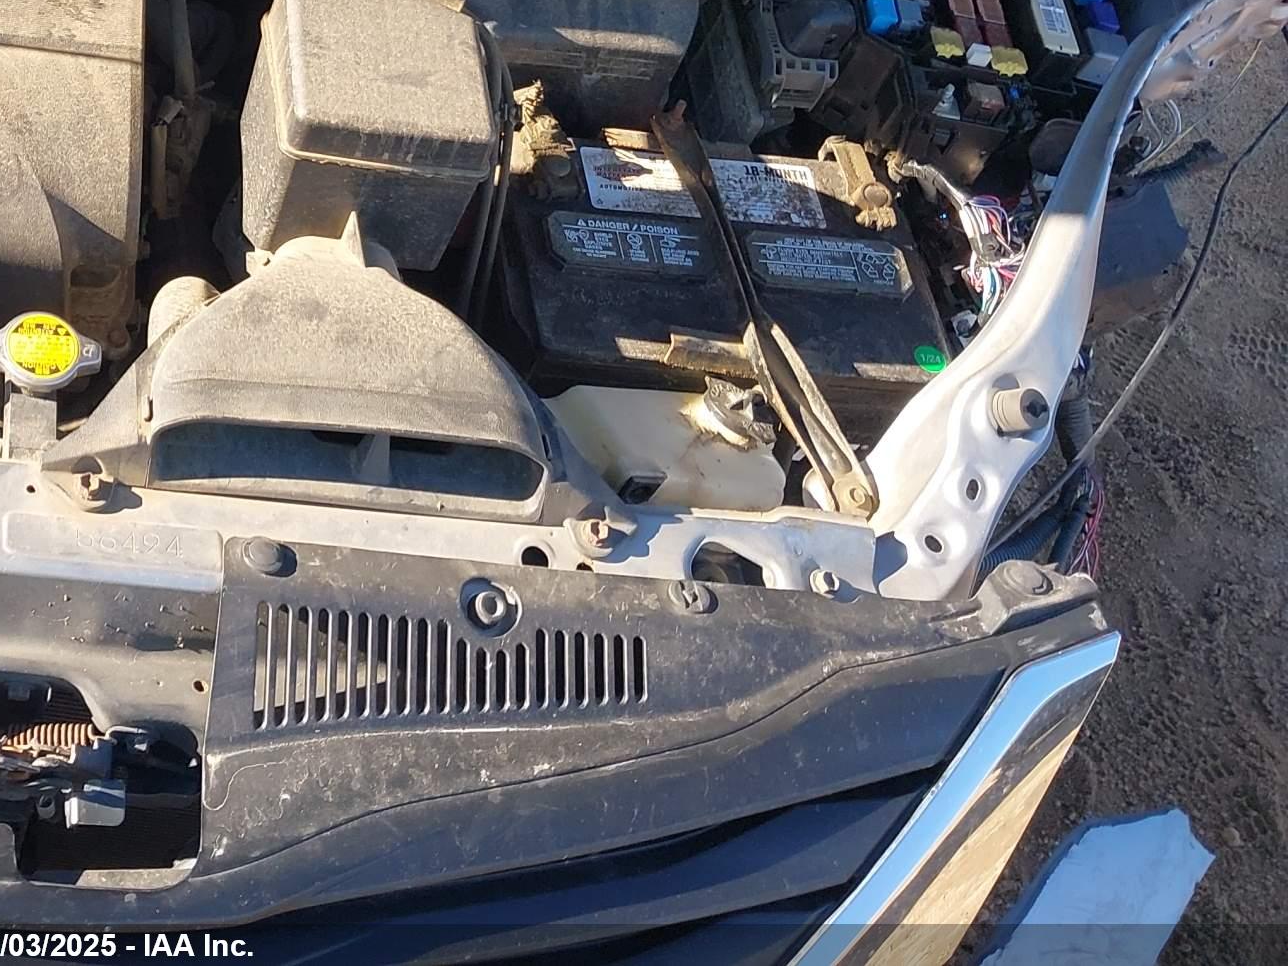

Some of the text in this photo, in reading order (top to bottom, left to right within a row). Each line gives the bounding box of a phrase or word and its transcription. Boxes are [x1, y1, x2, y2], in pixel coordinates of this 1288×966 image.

[743, 164, 808, 181] 18-MONTH
[587, 219, 630, 231] DANGER
[640, 225, 679, 235] POISON
[919, 353, 942, 364] 1/24
